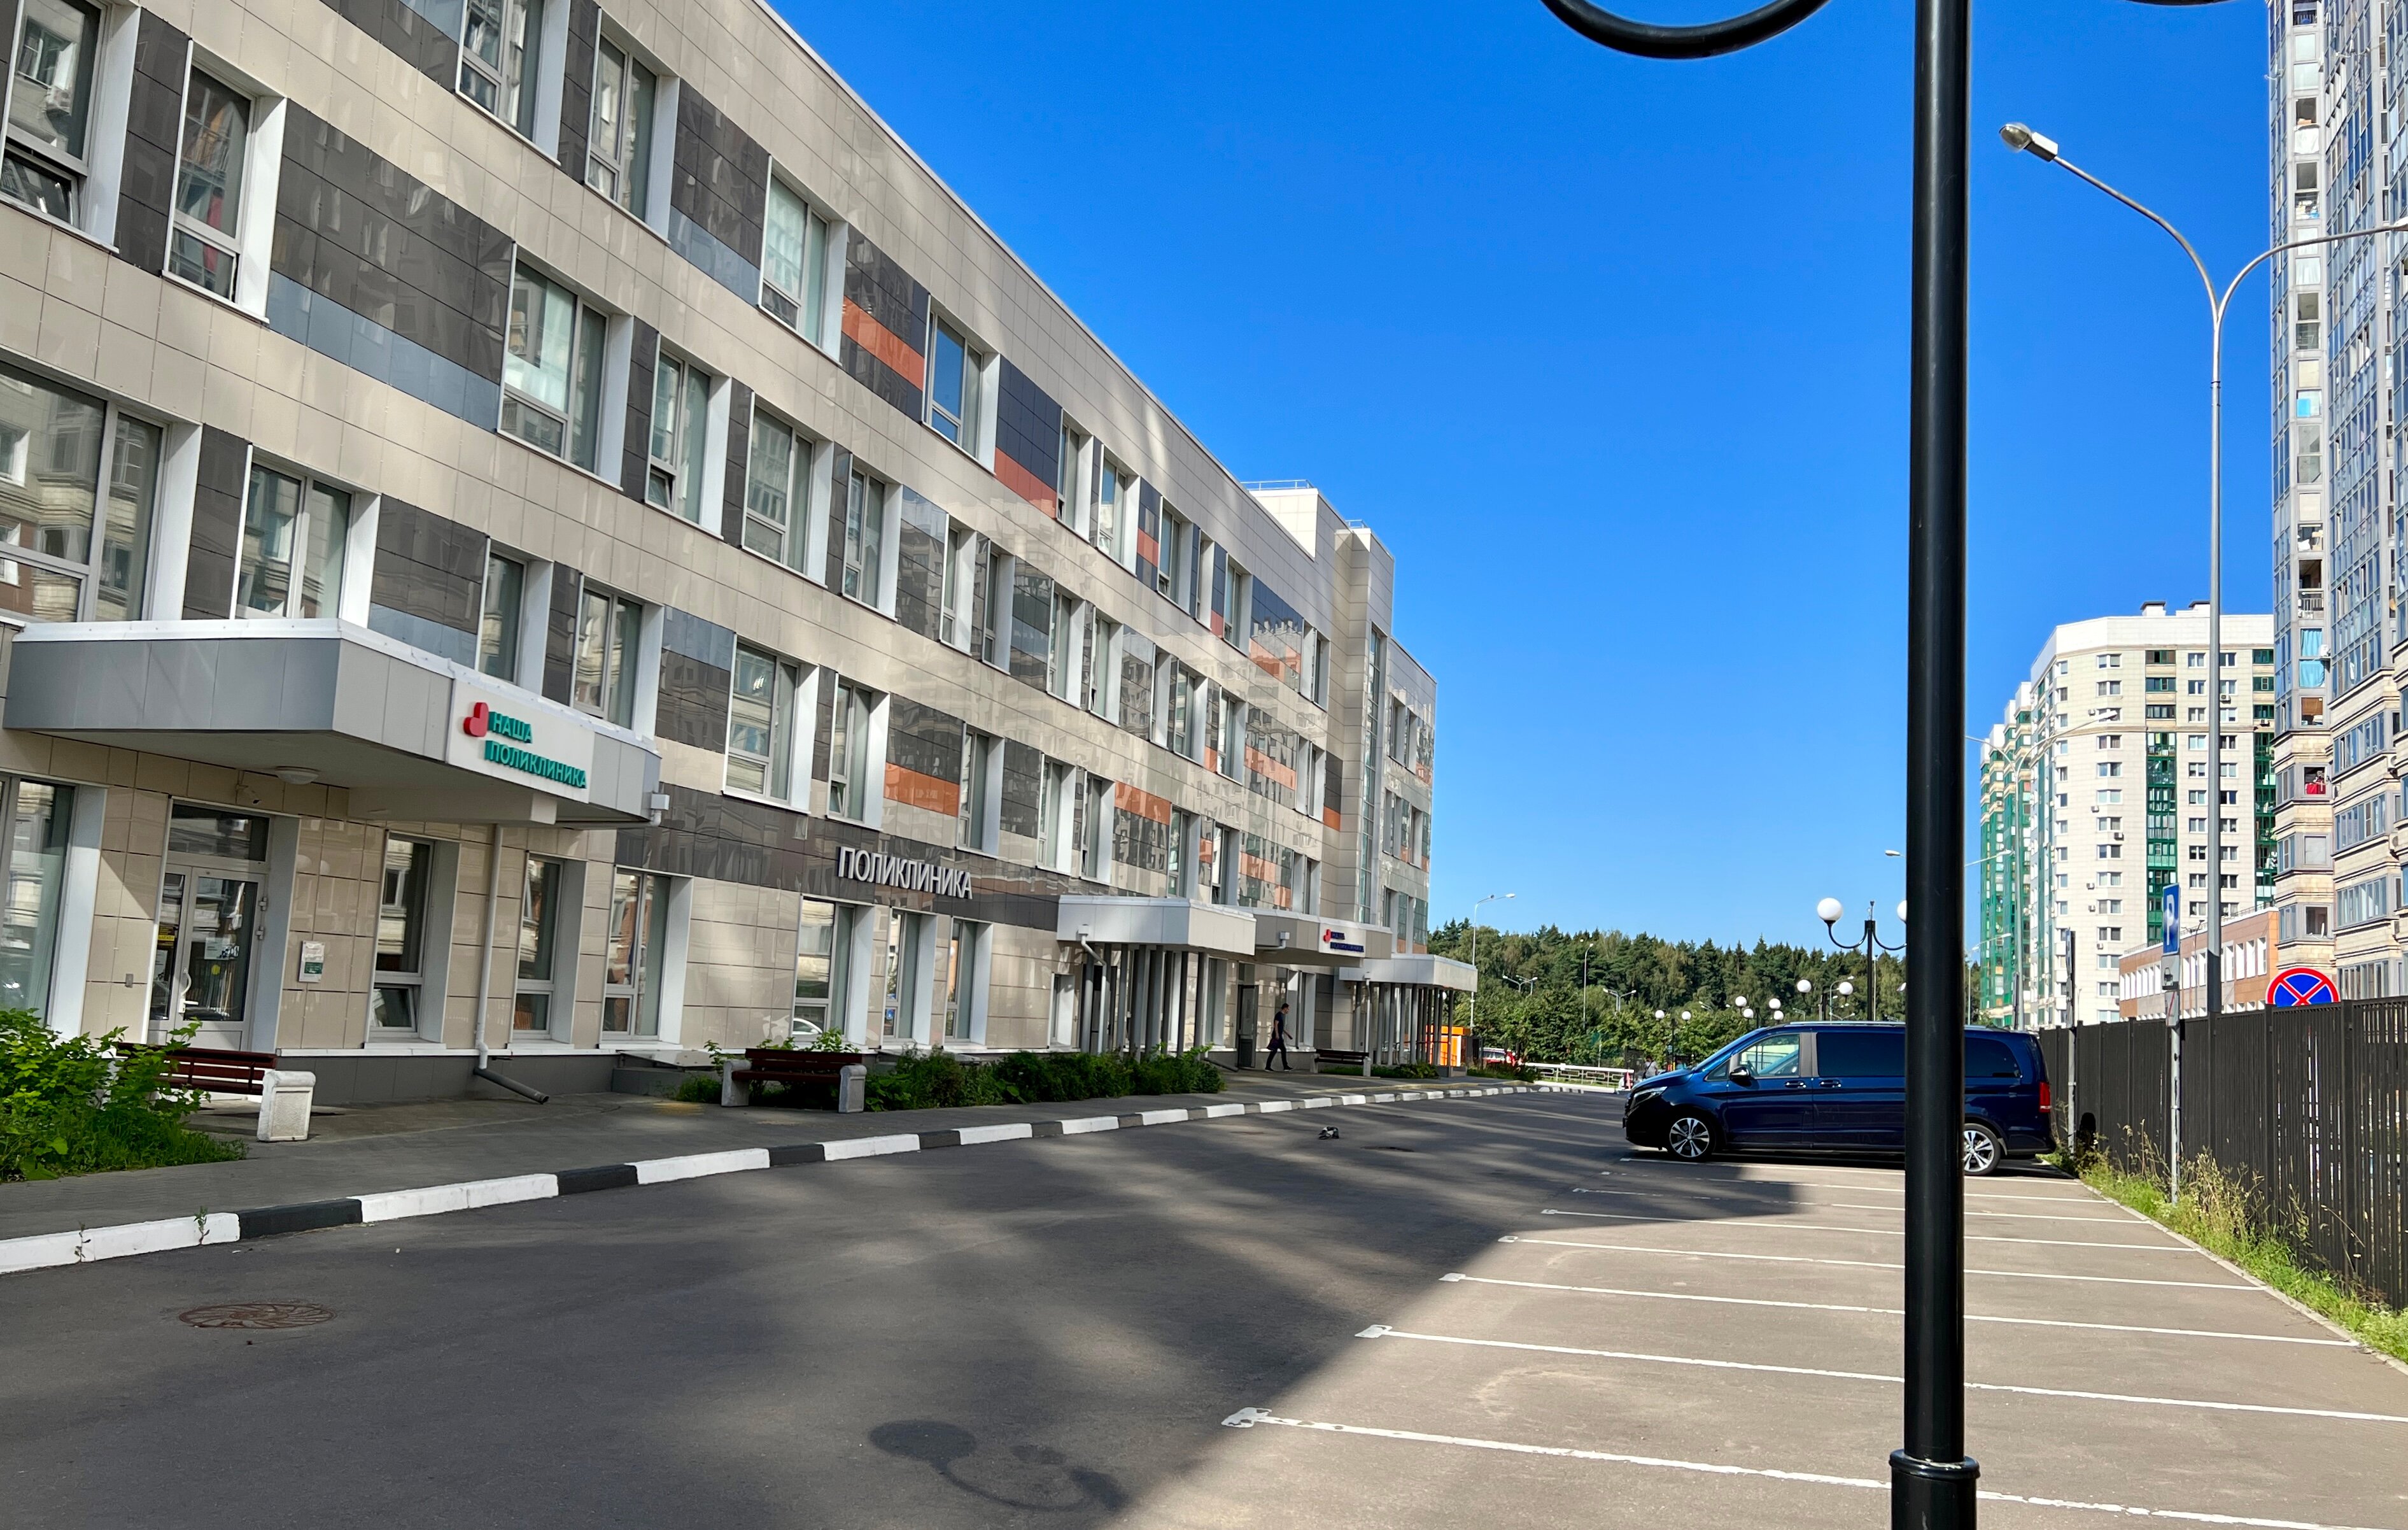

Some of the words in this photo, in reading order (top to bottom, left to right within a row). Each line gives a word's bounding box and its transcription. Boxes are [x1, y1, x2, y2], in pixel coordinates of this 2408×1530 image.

[489, 712, 532, 743] НАША
[486, 741, 587, 789] ПОЛИКЛИНИКА
[838, 846, 973, 900] ПОЛИКЛИНИКА
[2167, 894, 2175, 946] P
